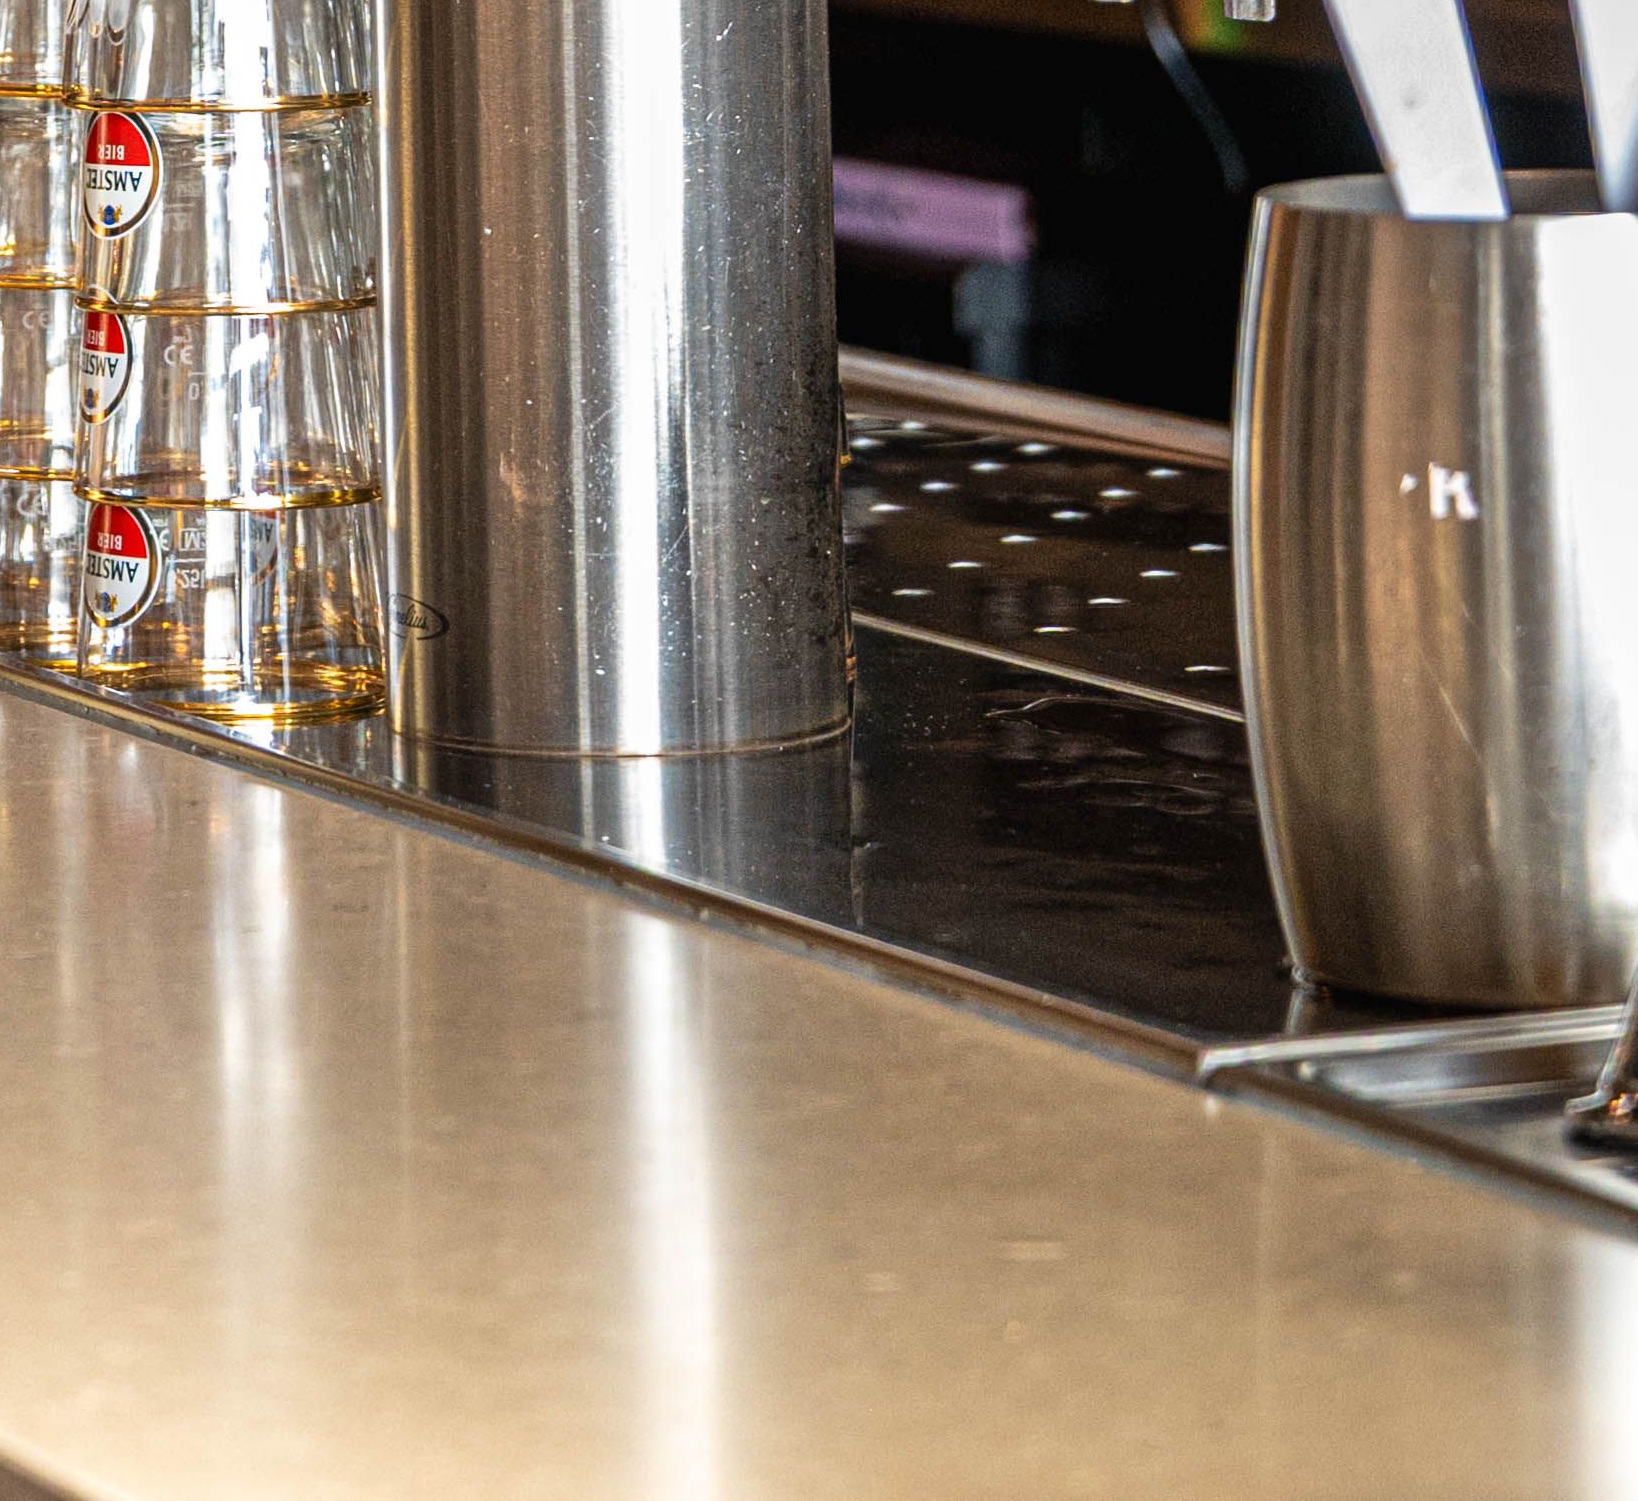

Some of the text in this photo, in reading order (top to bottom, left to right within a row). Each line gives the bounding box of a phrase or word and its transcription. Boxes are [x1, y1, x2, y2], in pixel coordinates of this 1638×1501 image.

[98, 144, 125, 161] BIER
[86, 167, 143, 192] AMSTEL
[97, 531, 122, 550] BIER
[86, 552, 140, 583] AMSTEL
